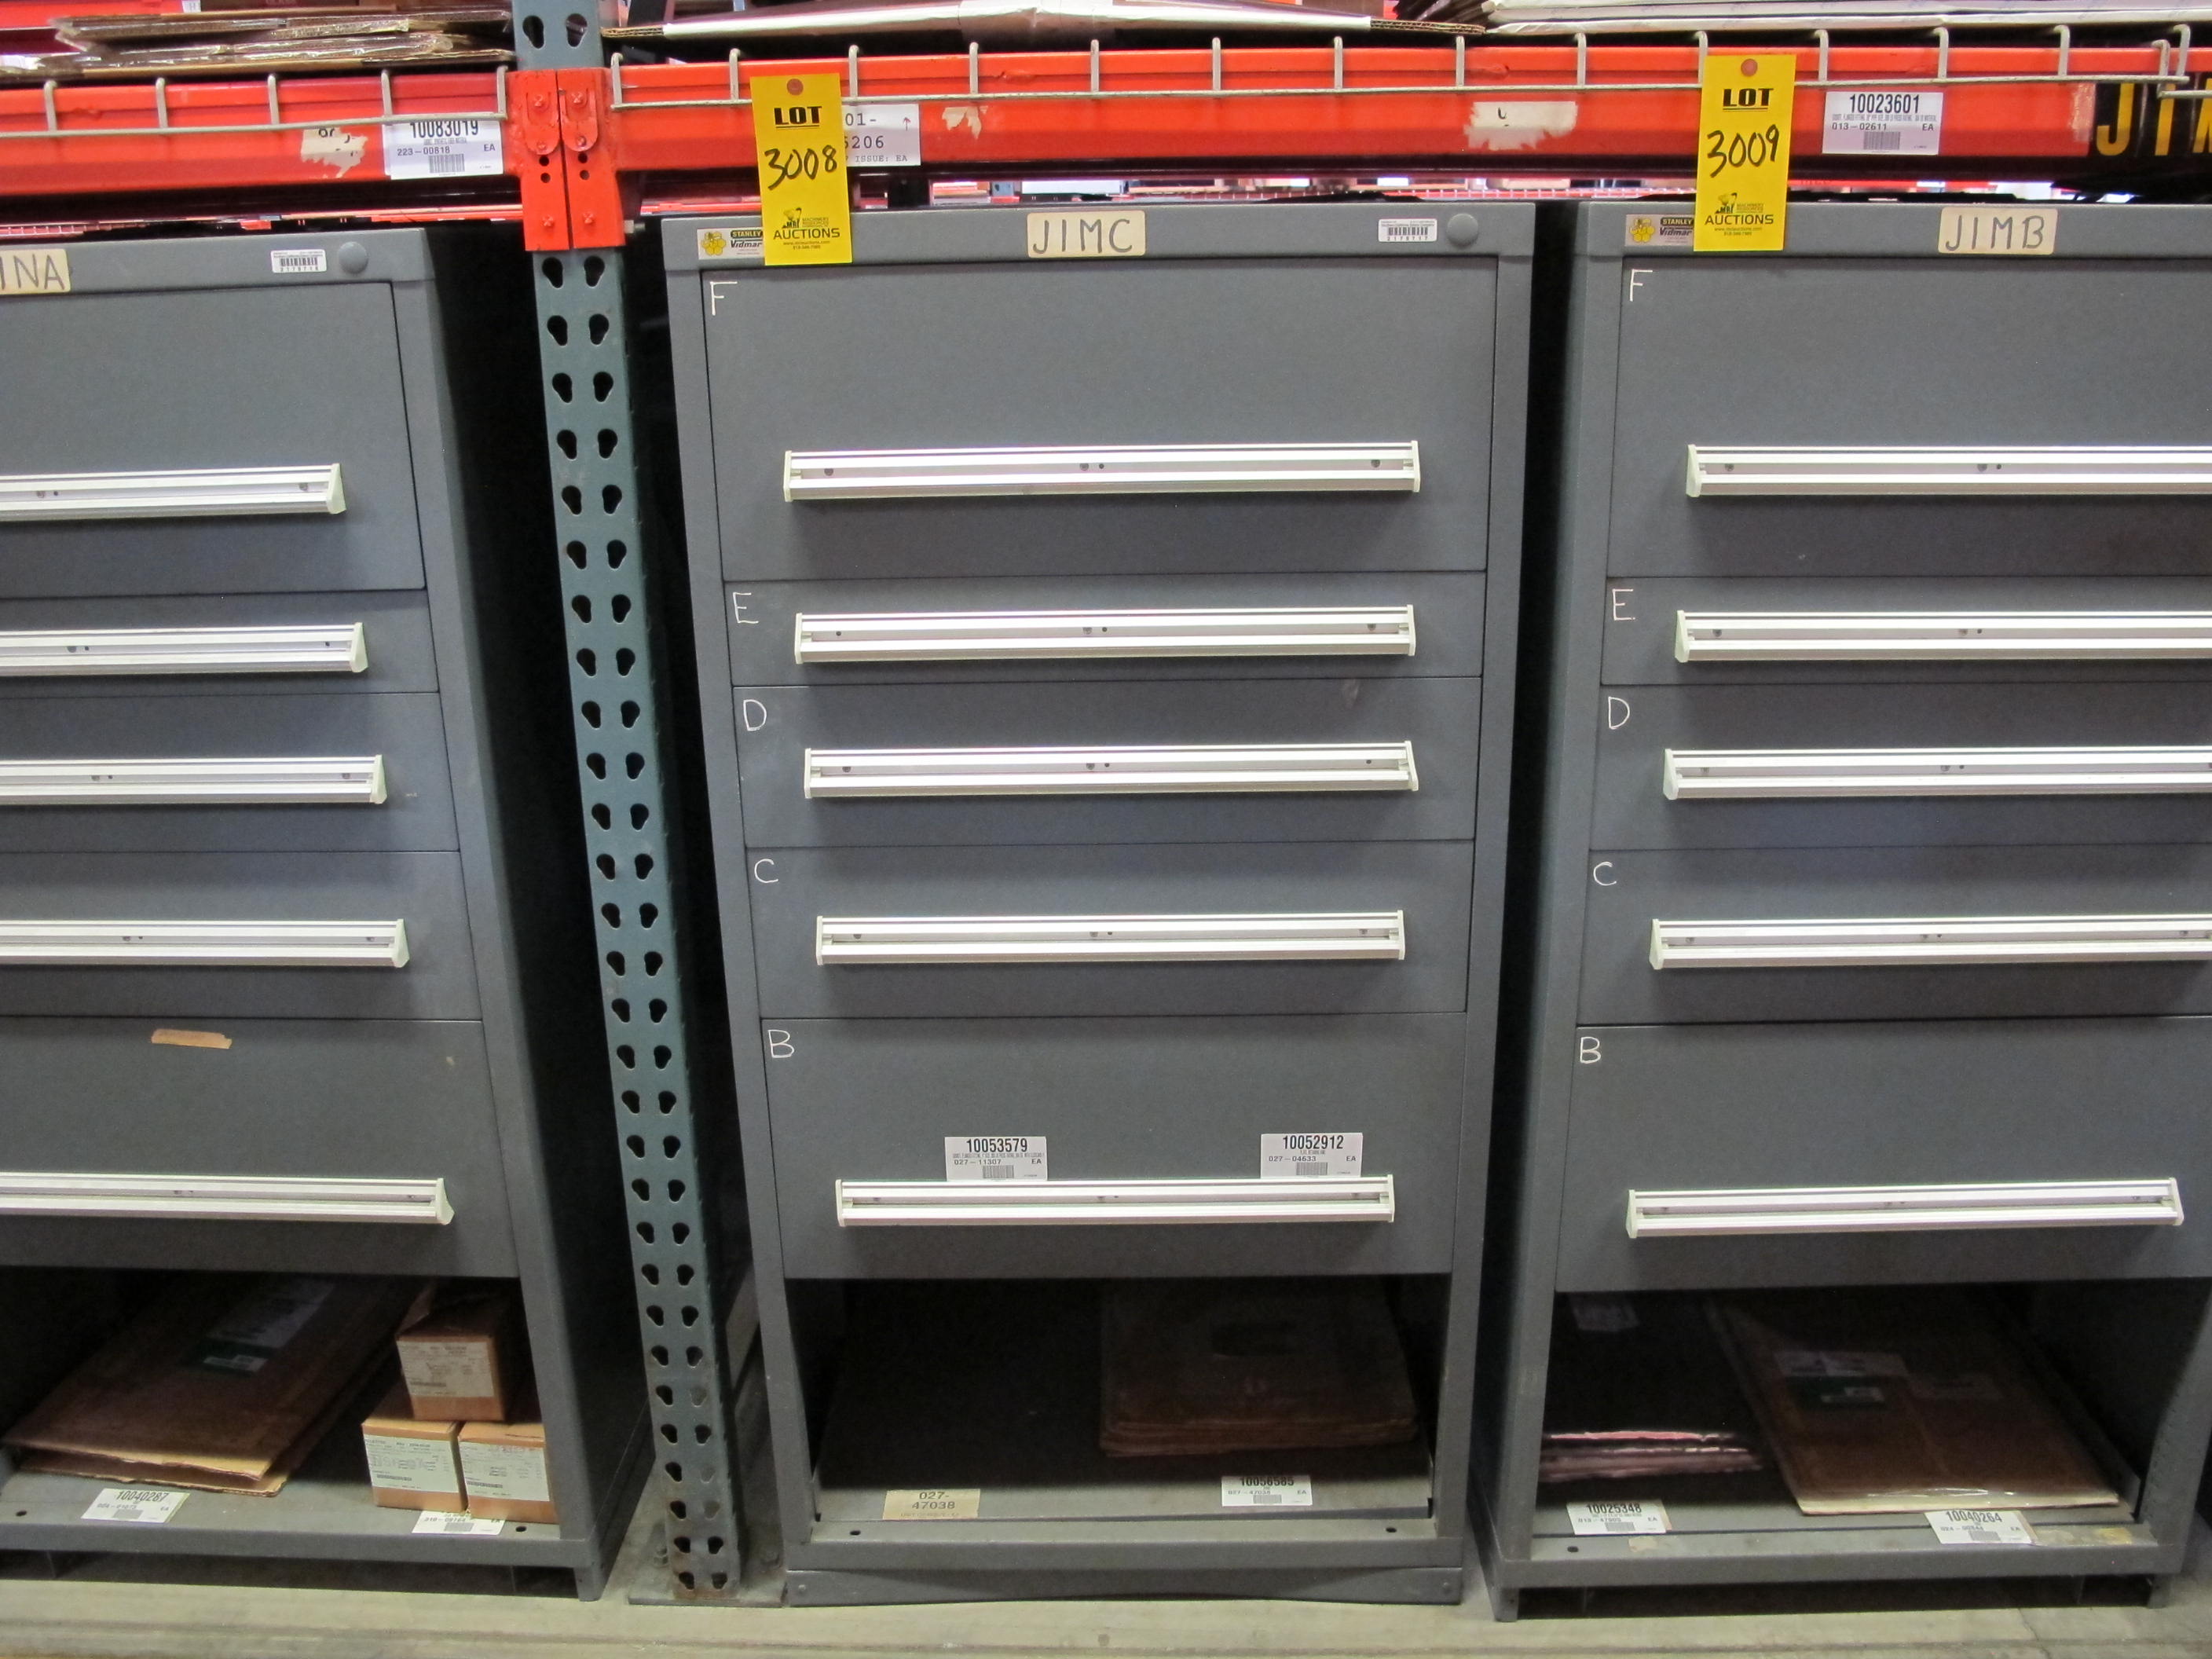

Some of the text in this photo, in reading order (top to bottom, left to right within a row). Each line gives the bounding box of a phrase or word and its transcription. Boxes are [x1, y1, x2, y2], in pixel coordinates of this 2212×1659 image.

[1723, 88, 1773, 107] LOT
[1850, 93, 1919, 113] 10023601
[774, 106, 822, 125] LOT
[410, 119, 479, 138] 10083019
[484, 143, 496, 152] EA
[1707, 124, 1779, 178] 3009
[764, 145, 837, 190] 3008
[1705, 214, 1774, 225] AUCTIONS
[773, 228, 840, 240] AUCTIONS
[1033, 218, 1133, 254] JIMC
[1660, 227, 1693, 236] Vidmar
[1946, 214, 2045, 251] JIMB
[731, 240, 763, 248] Vidmar
[1629, 269, 1653, 302] F
[709, 281, 738, 316] F
[733, 591, 760, 624] E
[1612, 588, 1635, 621] E
[743, 699, 767, 731] D
[1608, 696, 1631, 729] D
[754, 859, 779, 883] C
[1593, 862, 1617, 886] C
[767, 1030, 795, 1058] B
[1580, 1036, 1602, 1064] B
[966, 1138, 1027, 1152] 10053579
[1283, 1135, 1344, 1149] 10052912
[115, 1491, 170, 1502] 10040287
[912, 1501, 955, 1510] 47038
[1586, 1503, 1643, 1514] 10025348
[1946, 1510, 2003, 1522] 10040264
